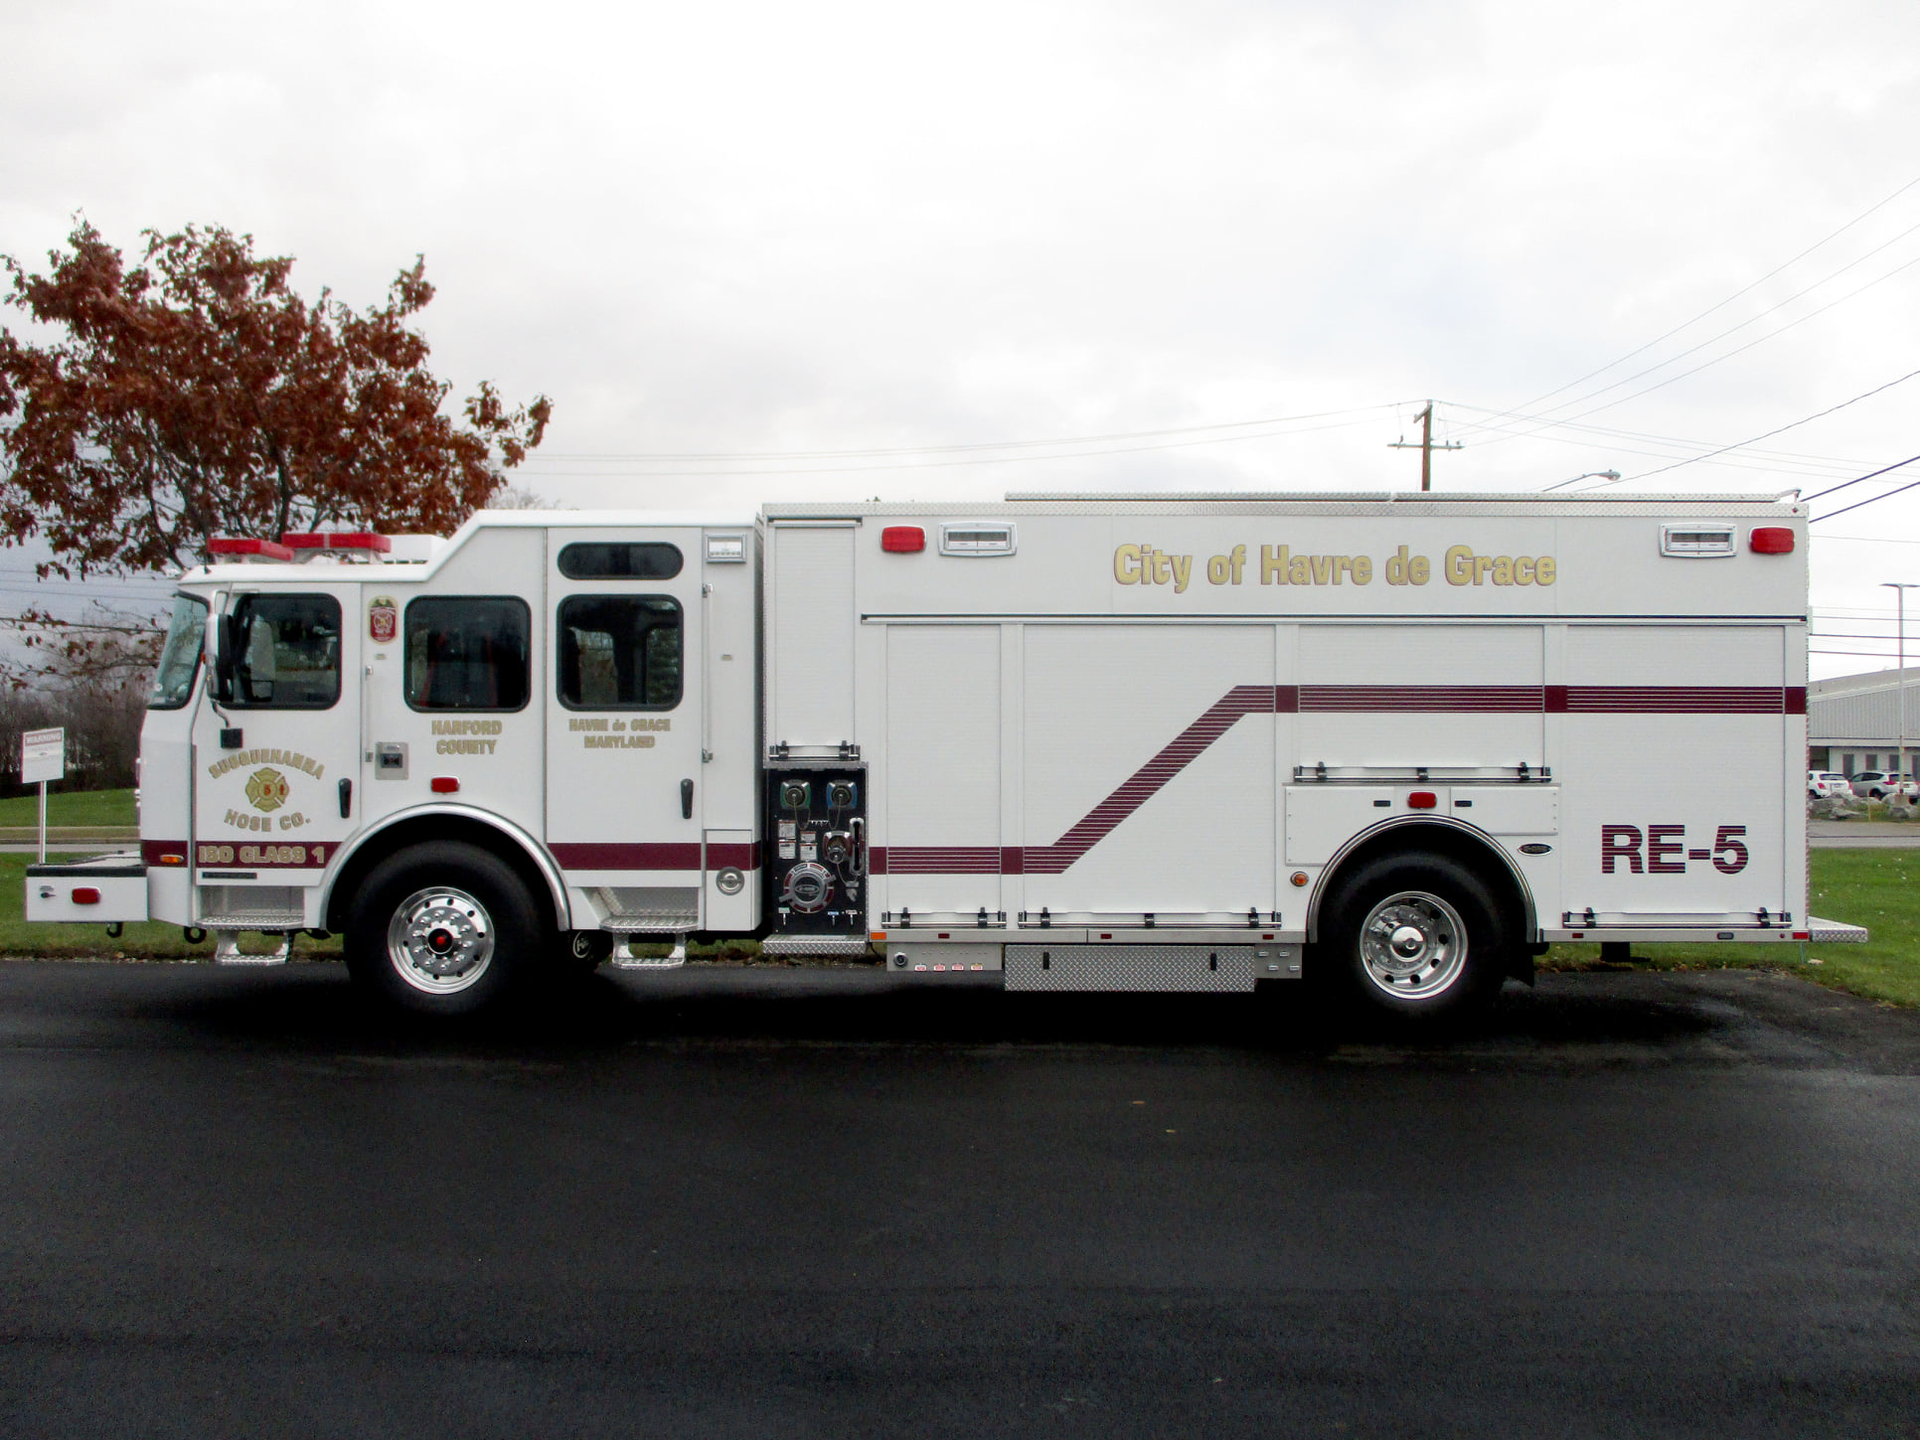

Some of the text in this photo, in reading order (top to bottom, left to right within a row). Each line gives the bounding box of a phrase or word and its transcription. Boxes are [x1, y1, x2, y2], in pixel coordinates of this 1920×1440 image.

[1114, 543, 1556, 594] City of Havre de Grace
[431, 720, 502, 735] HARFORD
[569, 719, 671, 732] HAVRE de GRACE
[436, 739, 497, 754] COUNTY
[584, 735, 655, 748] MARYLAND
[208, 748, 325, 779] SUSQUEHANNA
[223, 808, 311, 832] HOSE CO.
[198, 845, 325, 864] ISO CLASS 1
[1601, 824, 1749, 874] RE-5
